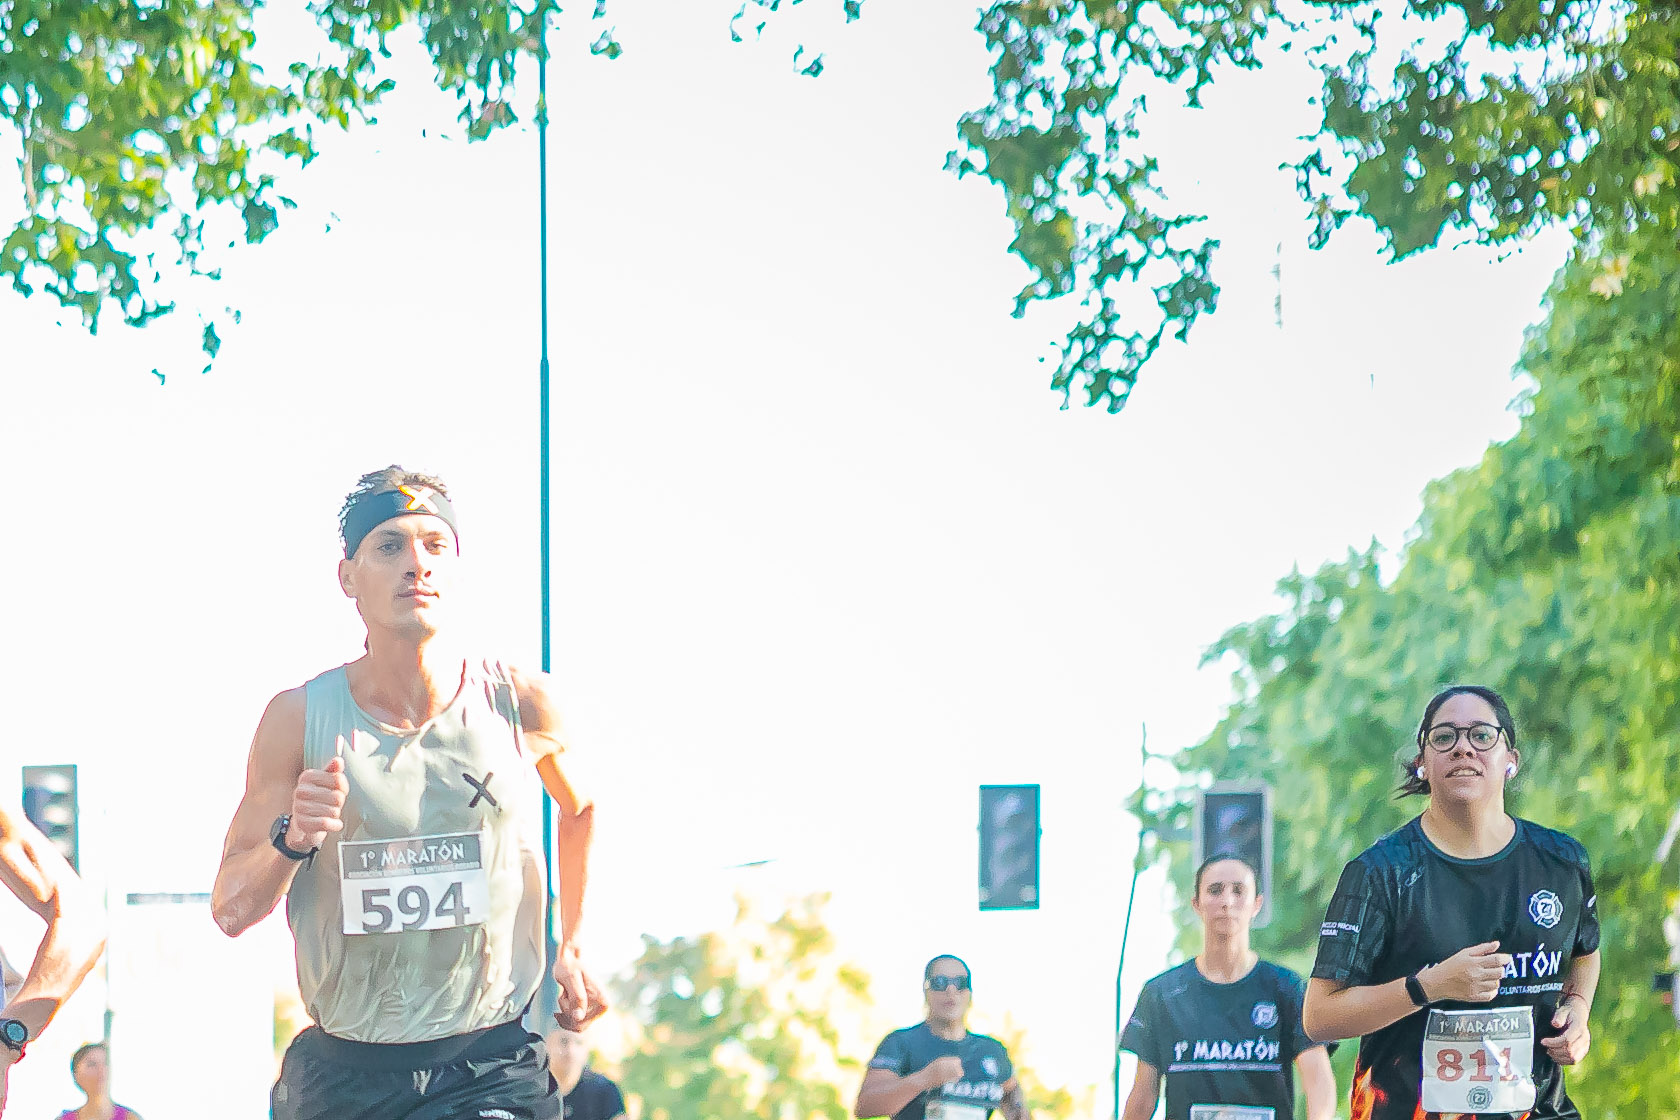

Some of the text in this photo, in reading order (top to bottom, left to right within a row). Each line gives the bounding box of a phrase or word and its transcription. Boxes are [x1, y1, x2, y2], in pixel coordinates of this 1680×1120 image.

[381, 840, 464, 867] MARATÓN
[361, 881, 470, 934] 594
[1504, 942, 1562, 979] ATÓN
[1454, 1015, 1520, 1033] MARATÓN
[1193, 1035, 1280, 1061] MARATÓN
